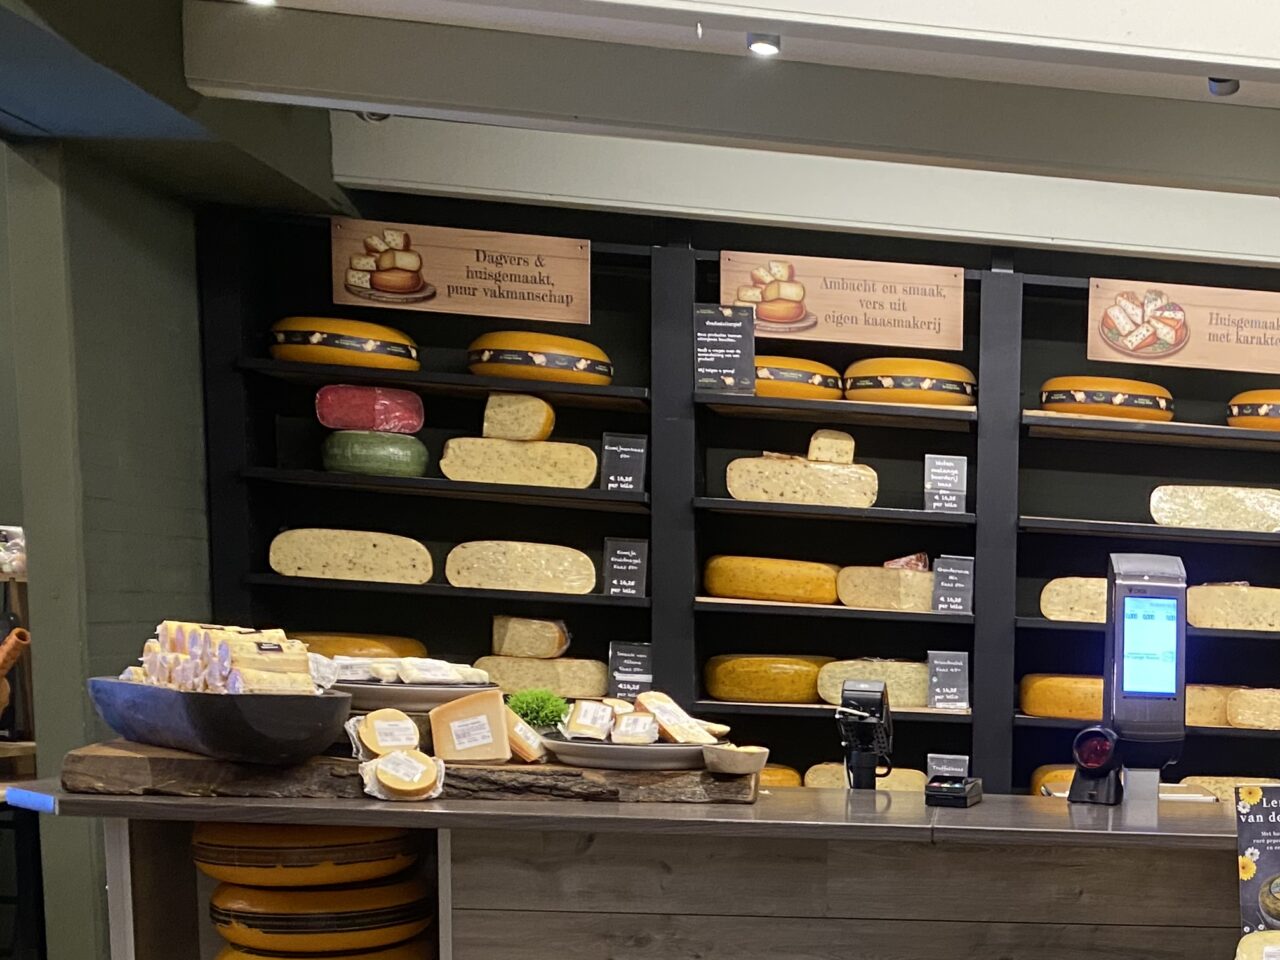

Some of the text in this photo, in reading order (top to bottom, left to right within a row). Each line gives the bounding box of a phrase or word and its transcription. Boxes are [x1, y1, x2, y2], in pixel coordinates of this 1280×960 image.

[475, 249, 545, 267] Dagvers &
[466, 266, 555, 286] huisgemaakt,
[447, 284, 574, 307] puur vakmanschap
[820, 276, 946, 299] Ambacht en smaak,
[859, 299, 907, 311] vers uit
[824, 311, 941, 334] eigen kaasmakerij
[1208, 332, 1231, 343] met
[1240, 814, 1264, 823] van
